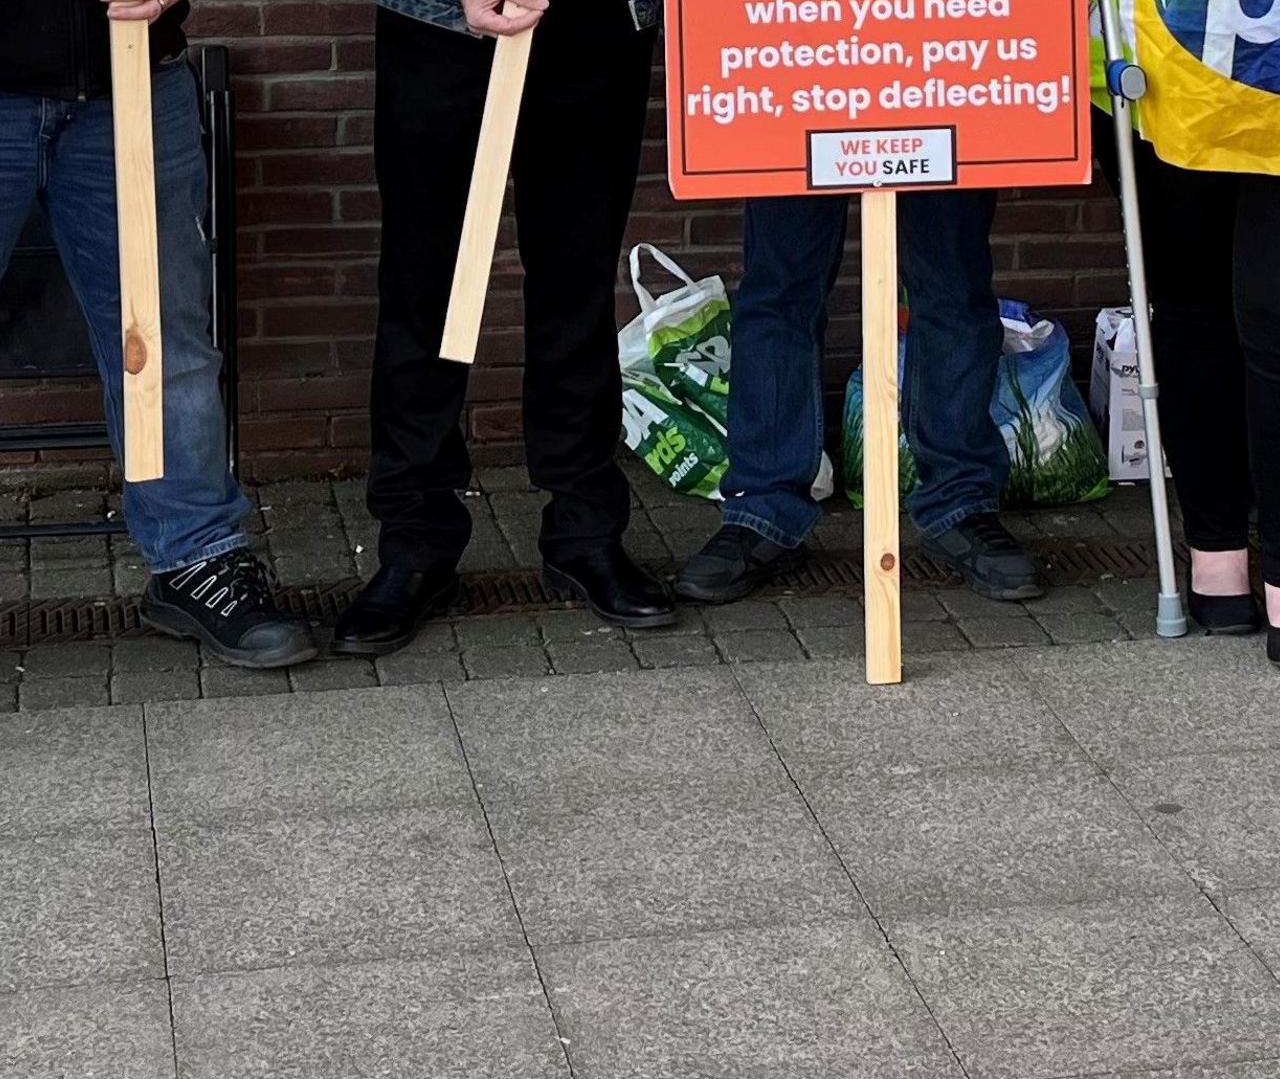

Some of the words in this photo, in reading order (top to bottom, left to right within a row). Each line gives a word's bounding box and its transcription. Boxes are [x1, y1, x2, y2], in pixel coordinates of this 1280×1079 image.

[721, 35, 914, 78] protection,
[922, 38, 989, 71] pay
[996, 36, 1038, 60] us
[686, 84, 785, 124] right,
[791, 86, 871, 120] stop
[878, 75, 1071, 114] deflecting!
[840, 140, 871, 155] WE
[876, 138, 923, 154] KEEP
[836, 161, 877, 177] YOU
[882, 158, 930, 175] SAFE
